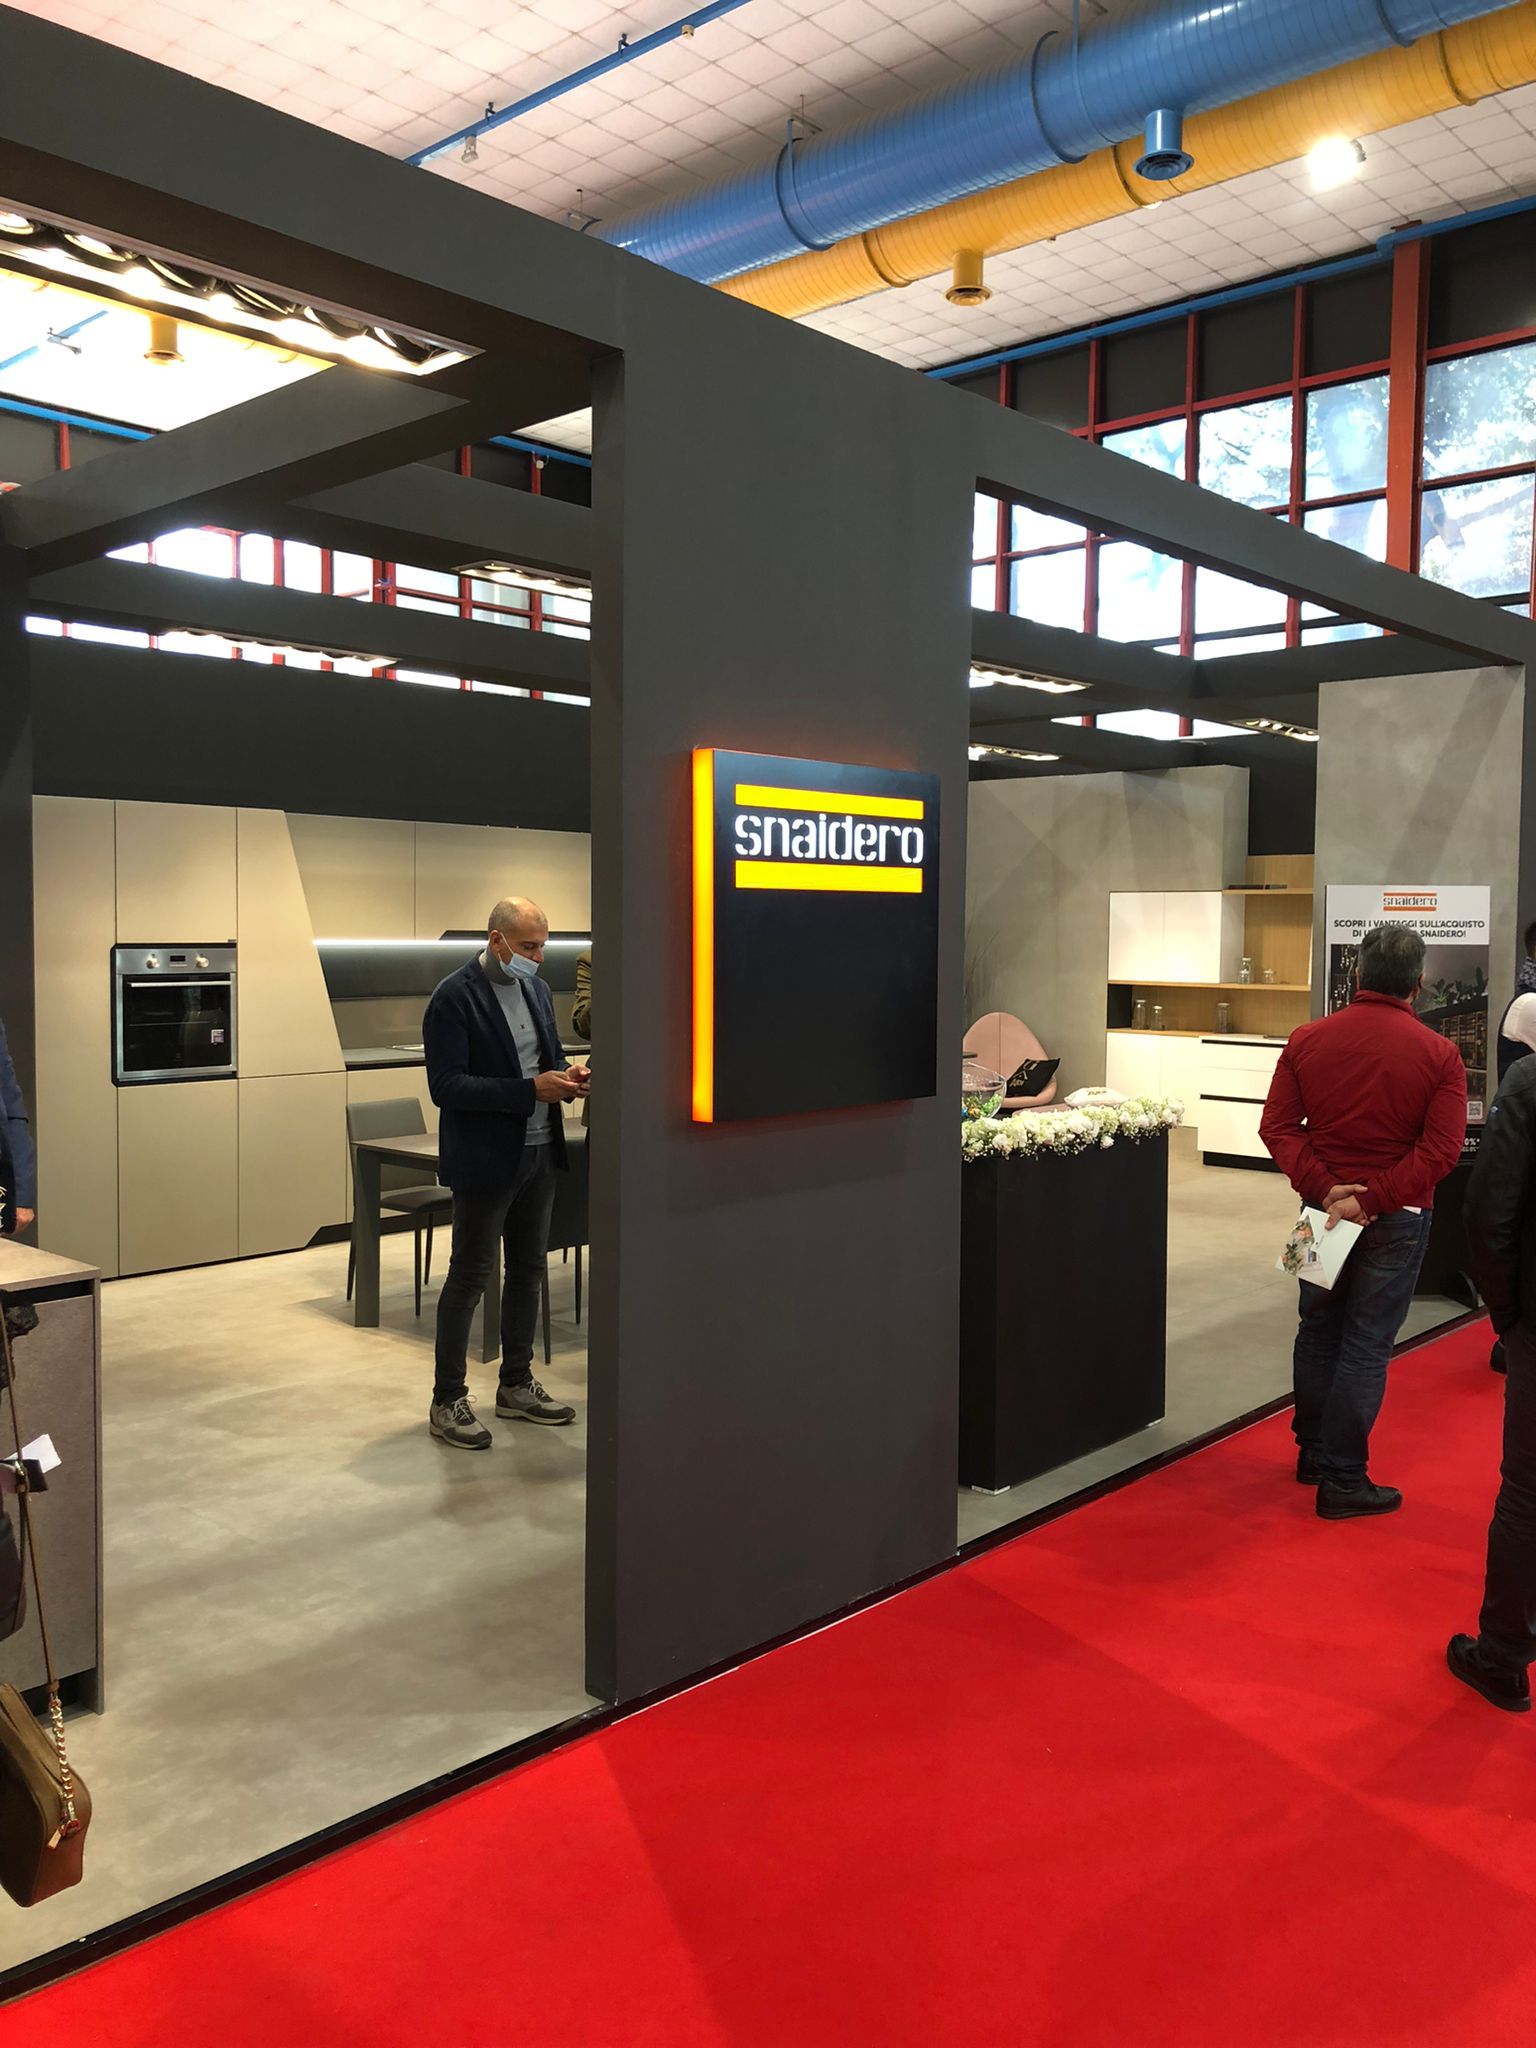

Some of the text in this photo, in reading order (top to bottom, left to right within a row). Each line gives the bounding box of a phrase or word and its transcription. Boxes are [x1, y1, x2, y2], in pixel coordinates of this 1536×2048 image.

[734, 813, 924, 864] snaidero
[1383, 896, 1437, 906] snaidero
[1334, 919, 1366, 928] SCOPRI
[1419, 920, 1485, 928] SULL'ACQUISTO
[1352, 929, 1362, 938] DI
[1420, 929, 1467, 938] SNAIDERO!
